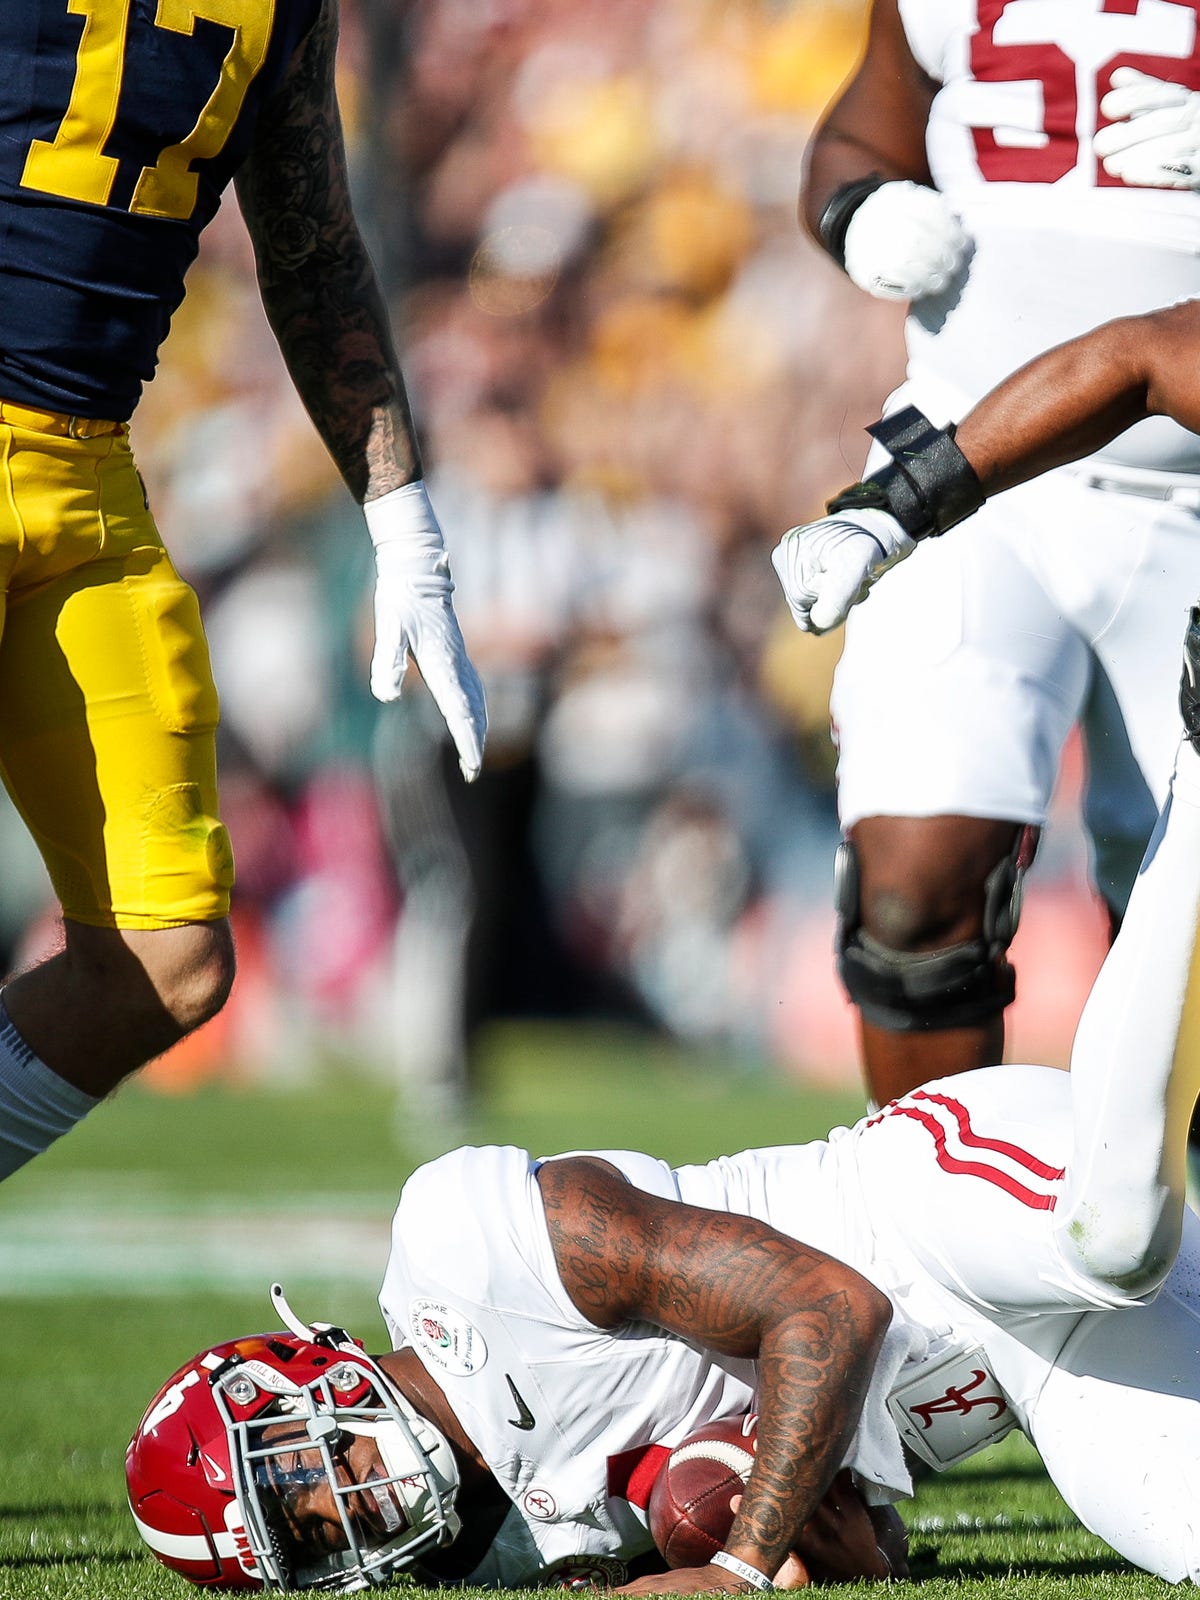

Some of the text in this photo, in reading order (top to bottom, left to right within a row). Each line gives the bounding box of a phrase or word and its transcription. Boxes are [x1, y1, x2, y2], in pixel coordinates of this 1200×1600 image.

[20, 0, 277, 219] 17
[143, 1369, 201, 1437] 4
[908, 1369, 1008, 1430] A
[734, 1563, 760, 1582] HYPE
